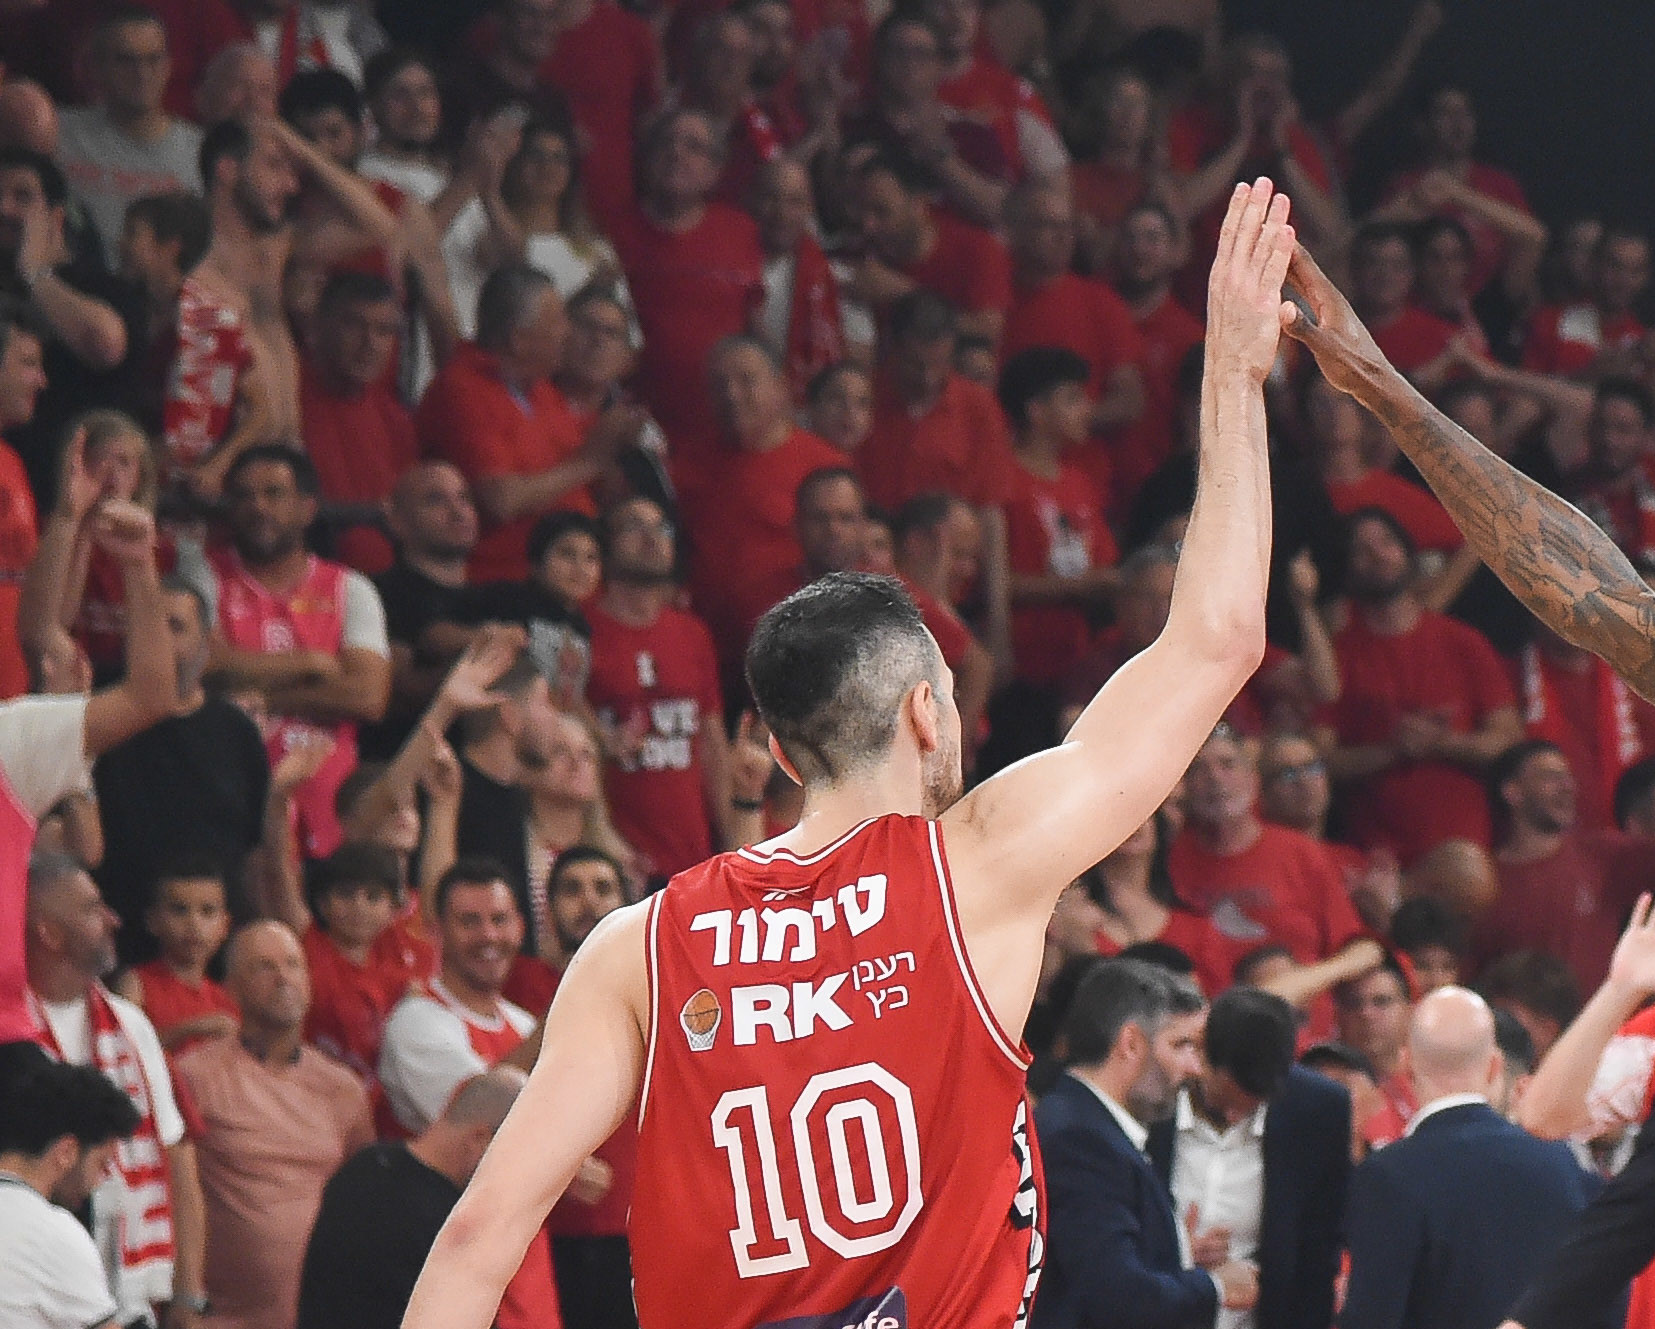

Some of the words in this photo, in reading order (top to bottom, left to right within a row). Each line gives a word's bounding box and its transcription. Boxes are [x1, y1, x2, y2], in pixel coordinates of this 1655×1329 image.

[690, 873, 888, 967] טימור
[852, 951, 916, 991] רענן
[865, 985, 910, 1019] כץ
[731, 972, 854, 1046] RK
[710, 1061, 924, 1279] 10
